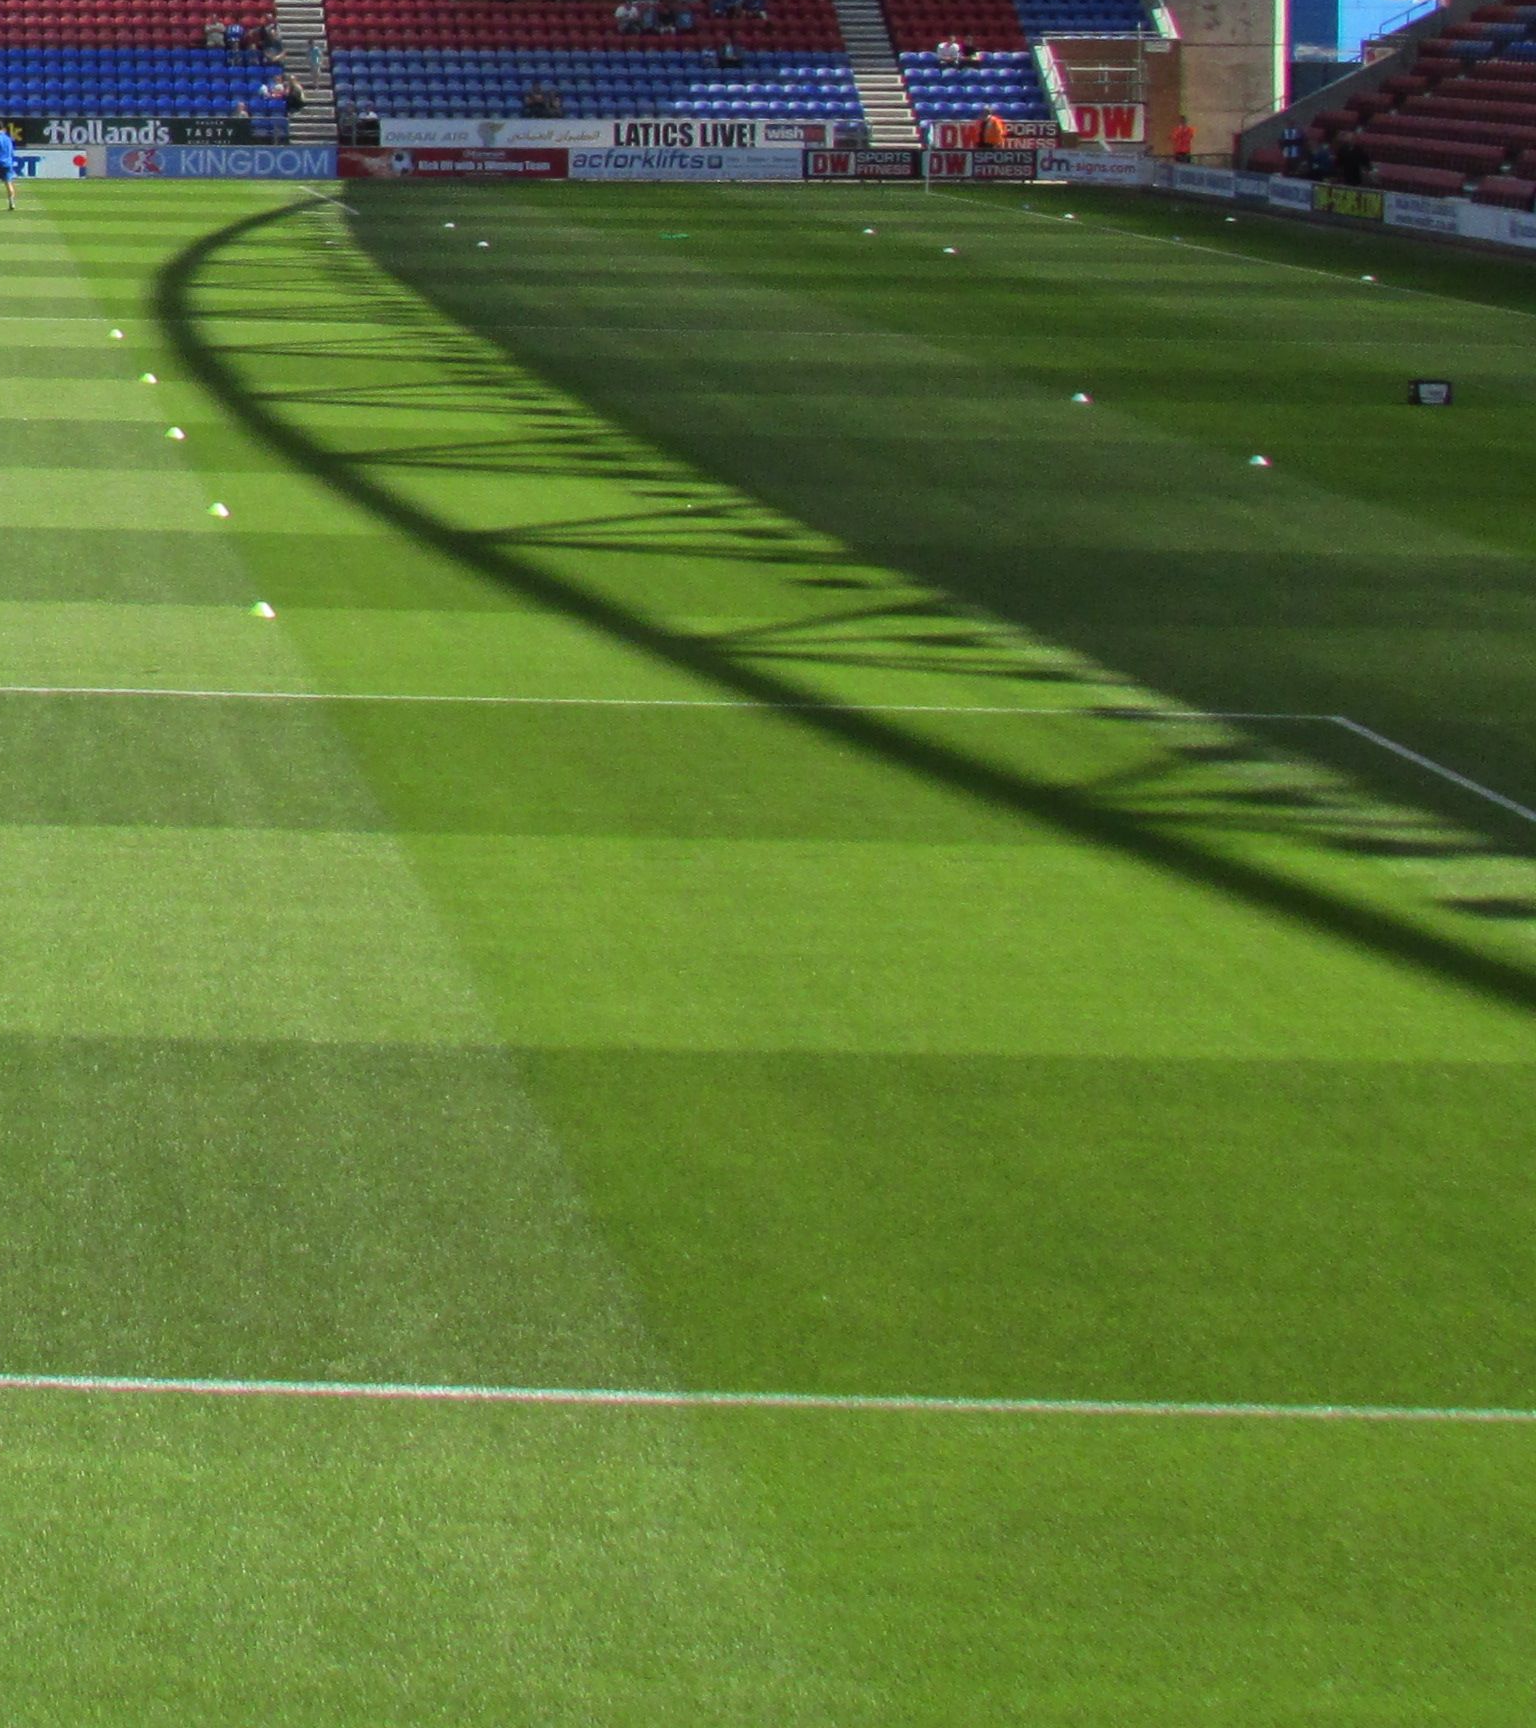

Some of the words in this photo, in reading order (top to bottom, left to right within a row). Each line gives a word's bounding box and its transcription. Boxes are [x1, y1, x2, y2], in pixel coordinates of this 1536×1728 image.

[43, 120, 171, 145] Holland's
[185, 127, 234, 137] TASTY
[1074, 106, 1137, 140] DW
[385, 131, 438, 142] OMAN
[441, 131, 470, 142] AIR
[613, 122, 694, 148] LATICS
[699, 122, 757, 148] LIVE!
[940, 124, 983, 149] DW
[180, 149, 330, 175] KINGDOM
[573, 149, 704, 169] acforklifts
[812, 152, 850, 175] DW
[856, 152, 912, 163] SPORTS
[929, 152, 968, 175] DW
[973, 152, 1033, 163] SPORTS
[1040, 154, 1136, 175] dm-signs.com
[856, 165, 912, 176] FITNESS
[973, 165, 1033, 176] FITNESS
